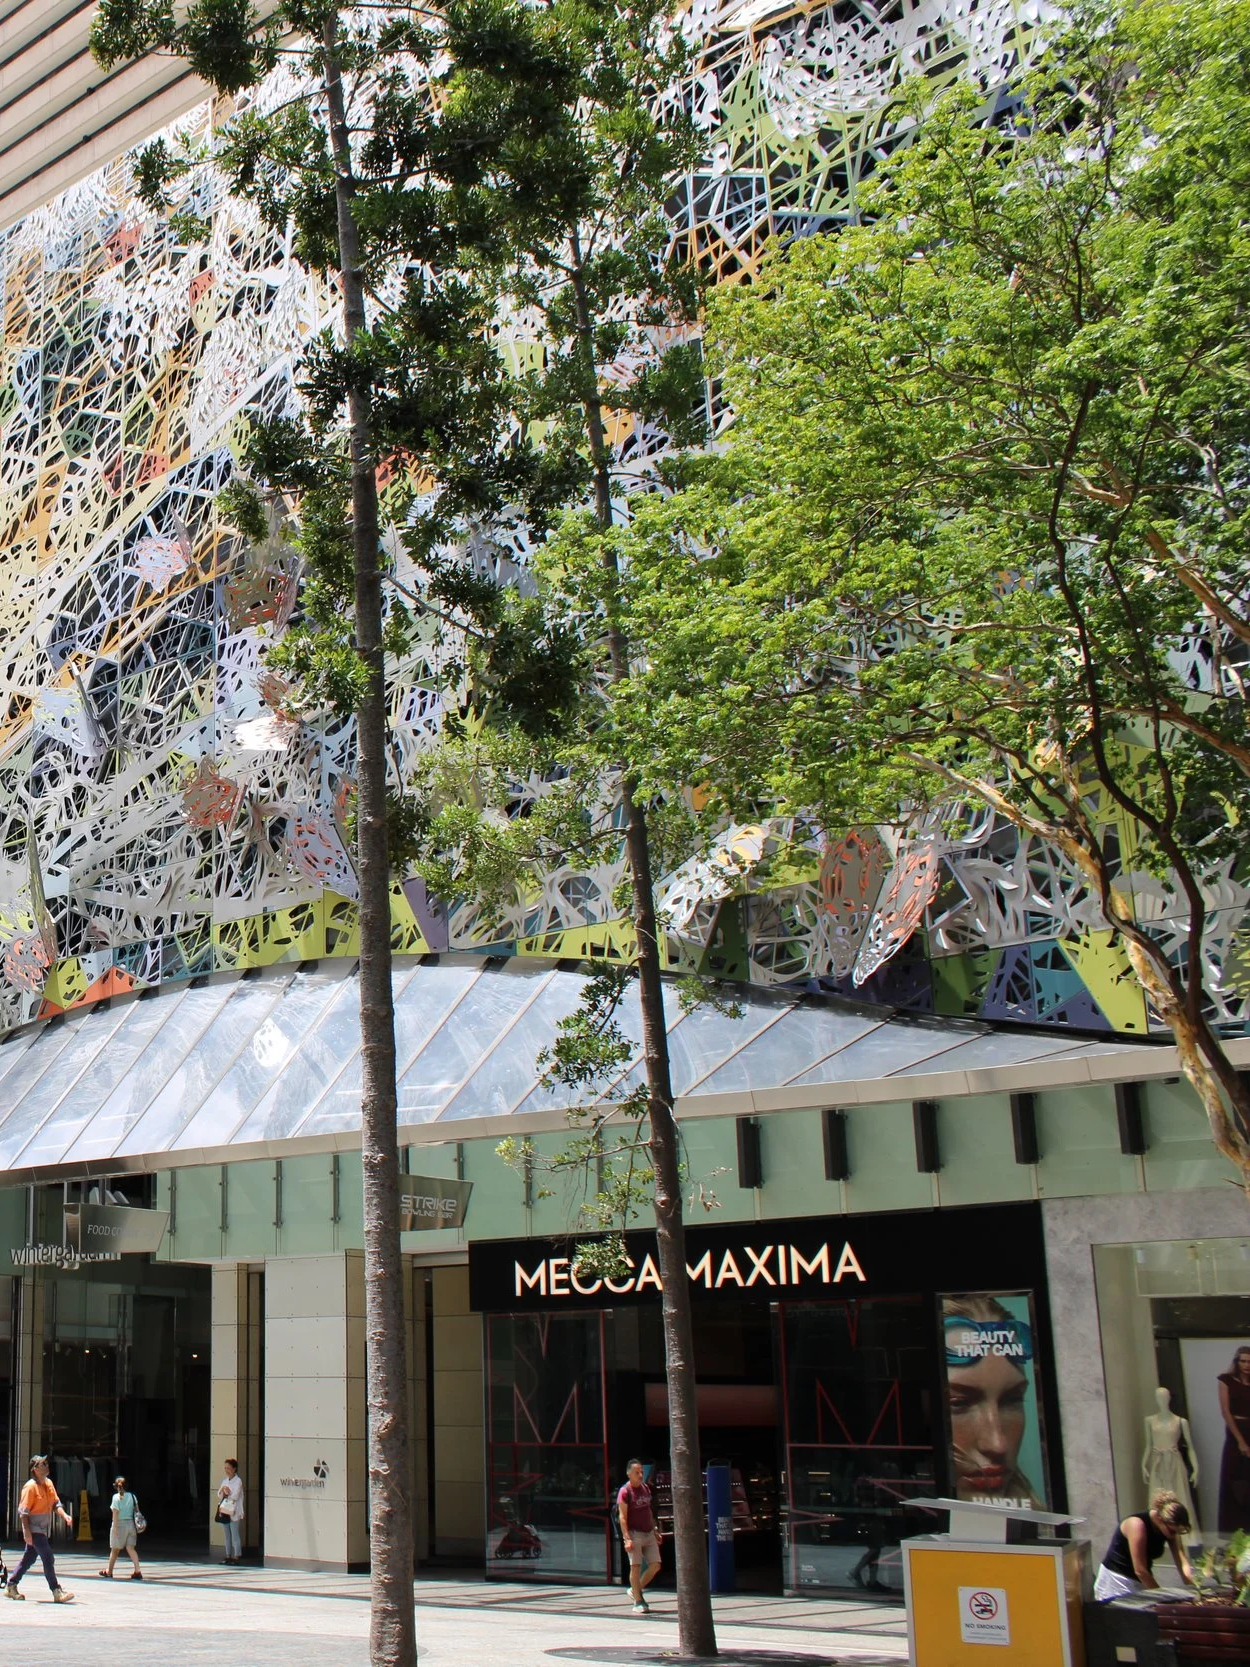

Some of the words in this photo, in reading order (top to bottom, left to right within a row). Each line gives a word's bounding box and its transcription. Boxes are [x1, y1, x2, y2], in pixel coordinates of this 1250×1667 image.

[400, 1194, 457, 1212] STRIKE
[401, 1208, 436, 1218] BOWLING
[87, 1224, 110, 1237] FOOD
[514, 1252, 663, 1297] MECCA
[685, 1241, 867, 1289] MAXIMA
[961, 1330, 1015, 1344] BEAUTY
[955, 1344, 991, 1357] THAT
[992, 1343, 1024, 1356] CAN
[976, 1623, 1006, 1631] SMOKING
